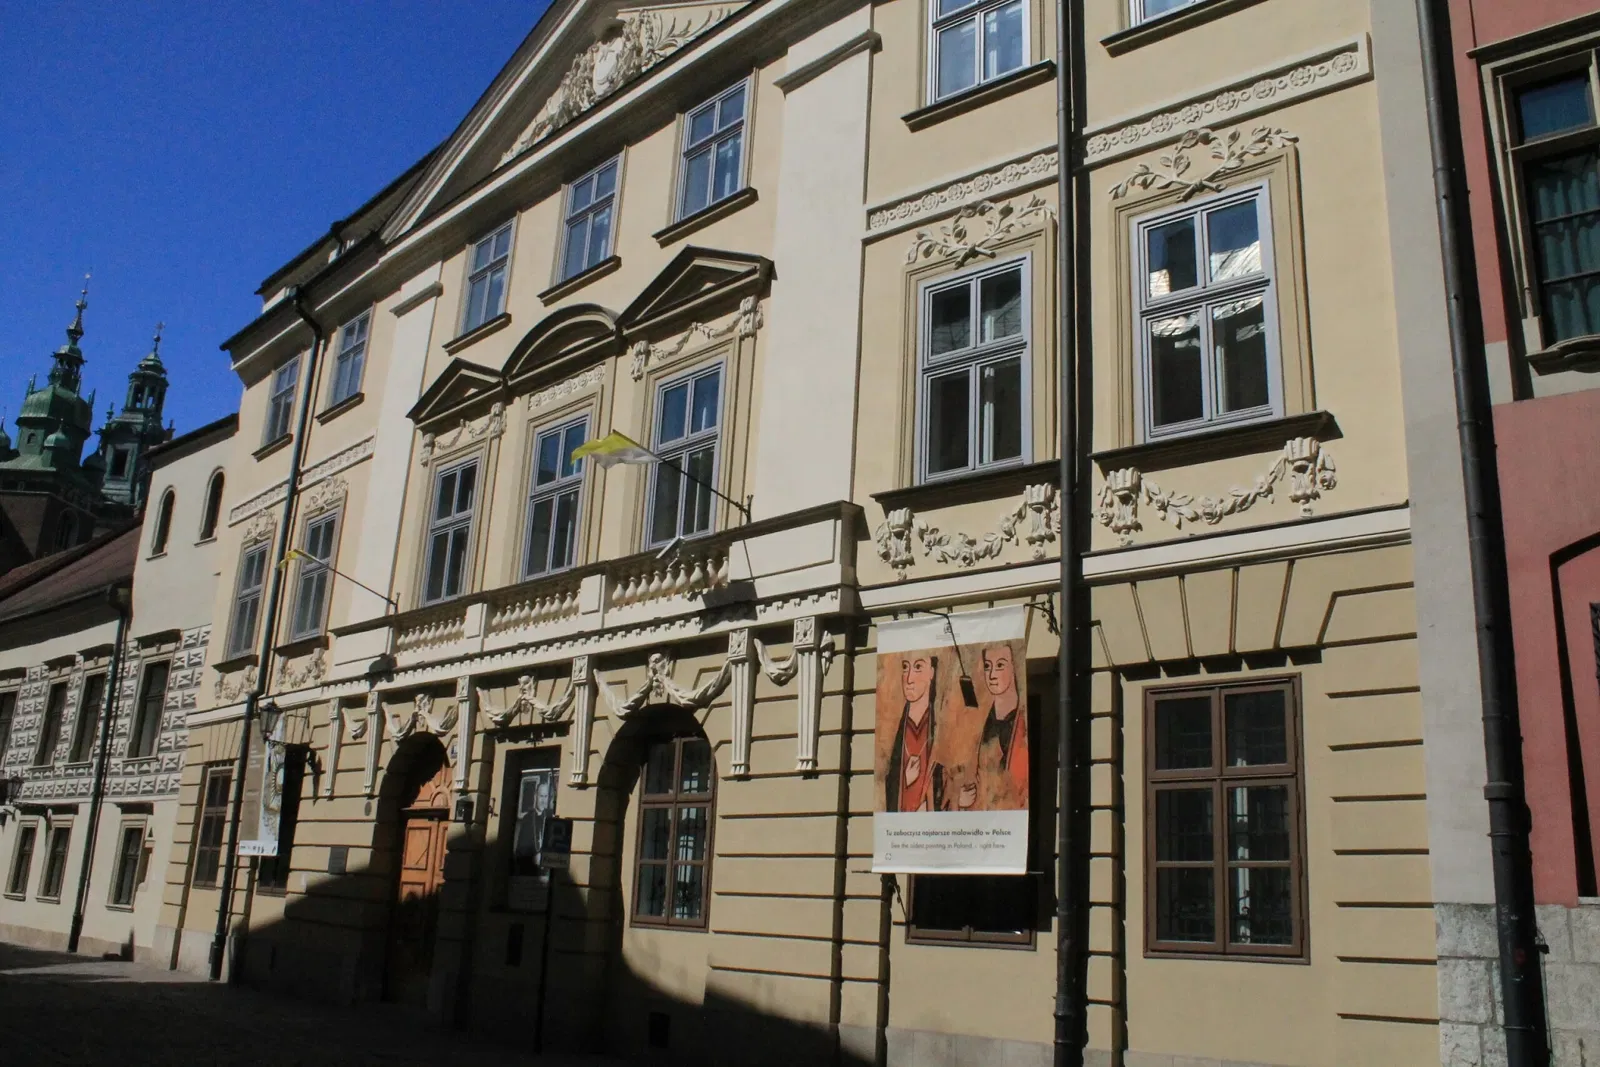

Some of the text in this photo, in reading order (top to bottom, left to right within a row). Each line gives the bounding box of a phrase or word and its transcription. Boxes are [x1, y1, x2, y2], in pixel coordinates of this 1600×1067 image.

[893, 829, 921, 838] zobaczysz
[921, 829, 950, 838] najstarsze
[951, 828, 984, 836] malowidło
[992, 828, 1012, 836] Polsce
[925, 842, 946, 851] painting
[953, 841, 972, 849] Poland
